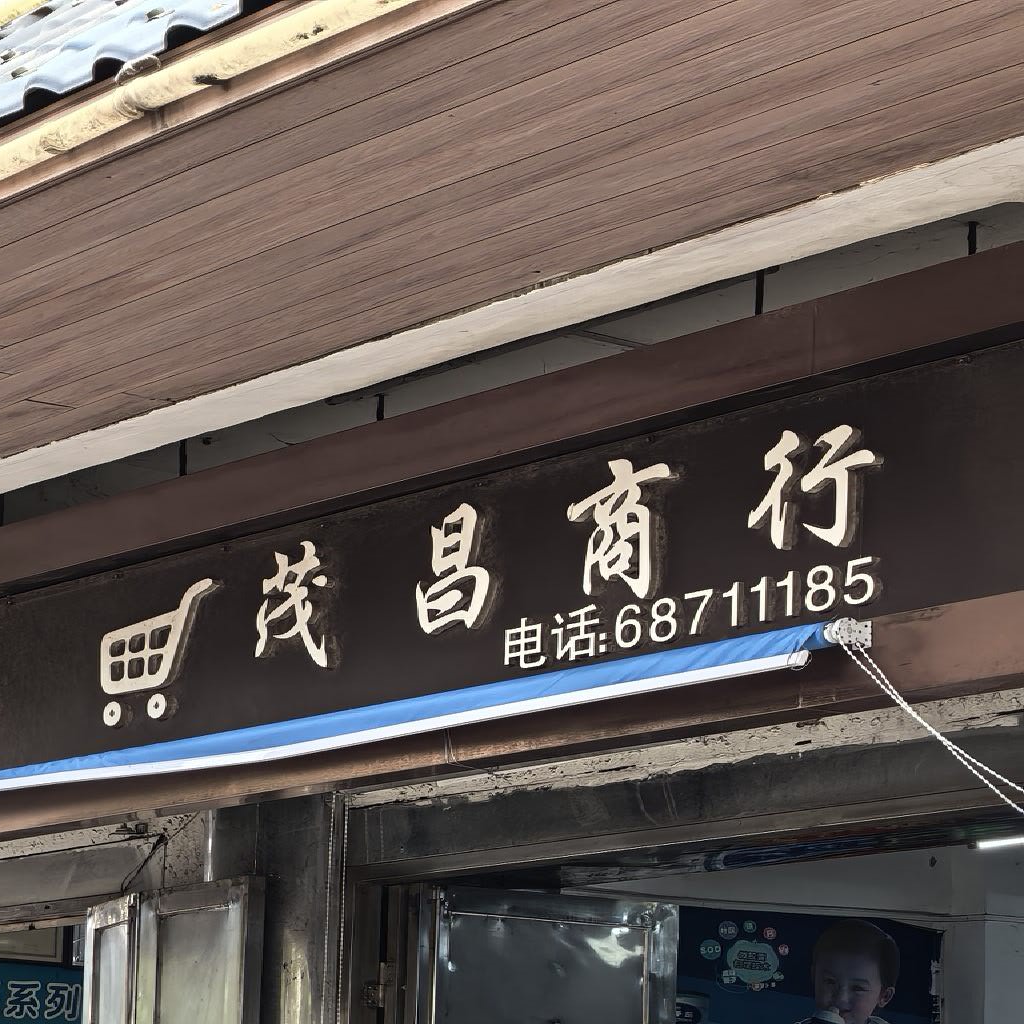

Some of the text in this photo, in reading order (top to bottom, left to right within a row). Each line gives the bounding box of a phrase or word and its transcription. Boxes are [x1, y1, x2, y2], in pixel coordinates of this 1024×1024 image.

[255, 424, 878, 669] 茂昌商行
[502, 557, 875, 670] 电话:68711185
